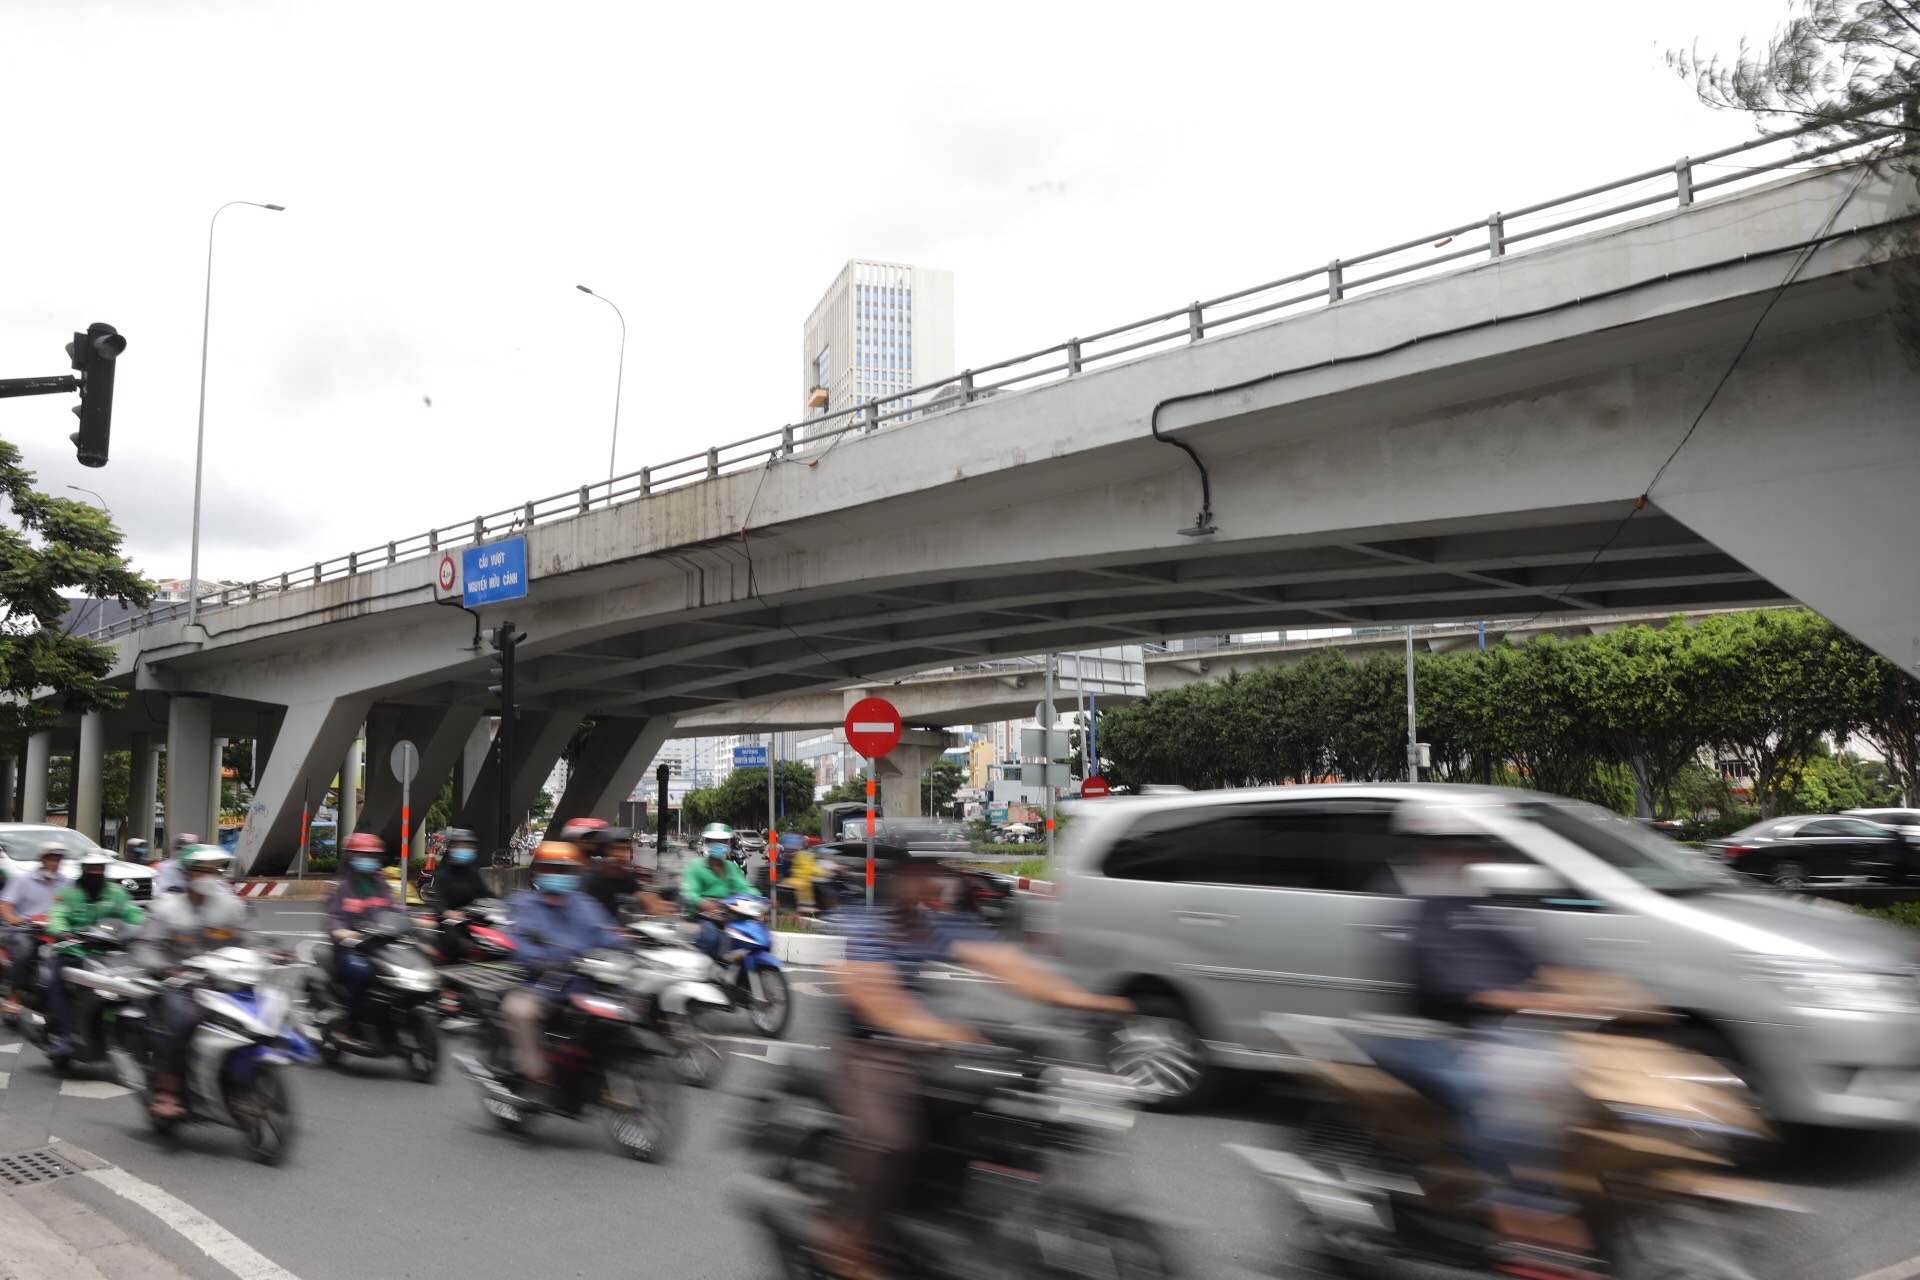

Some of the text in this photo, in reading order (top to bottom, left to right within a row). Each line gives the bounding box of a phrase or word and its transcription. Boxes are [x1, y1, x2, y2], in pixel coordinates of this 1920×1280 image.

[490, 551, 506, 567] VƯỢT
[467, 570, 518, 593] NGUYỄN HỮU CẢNH
